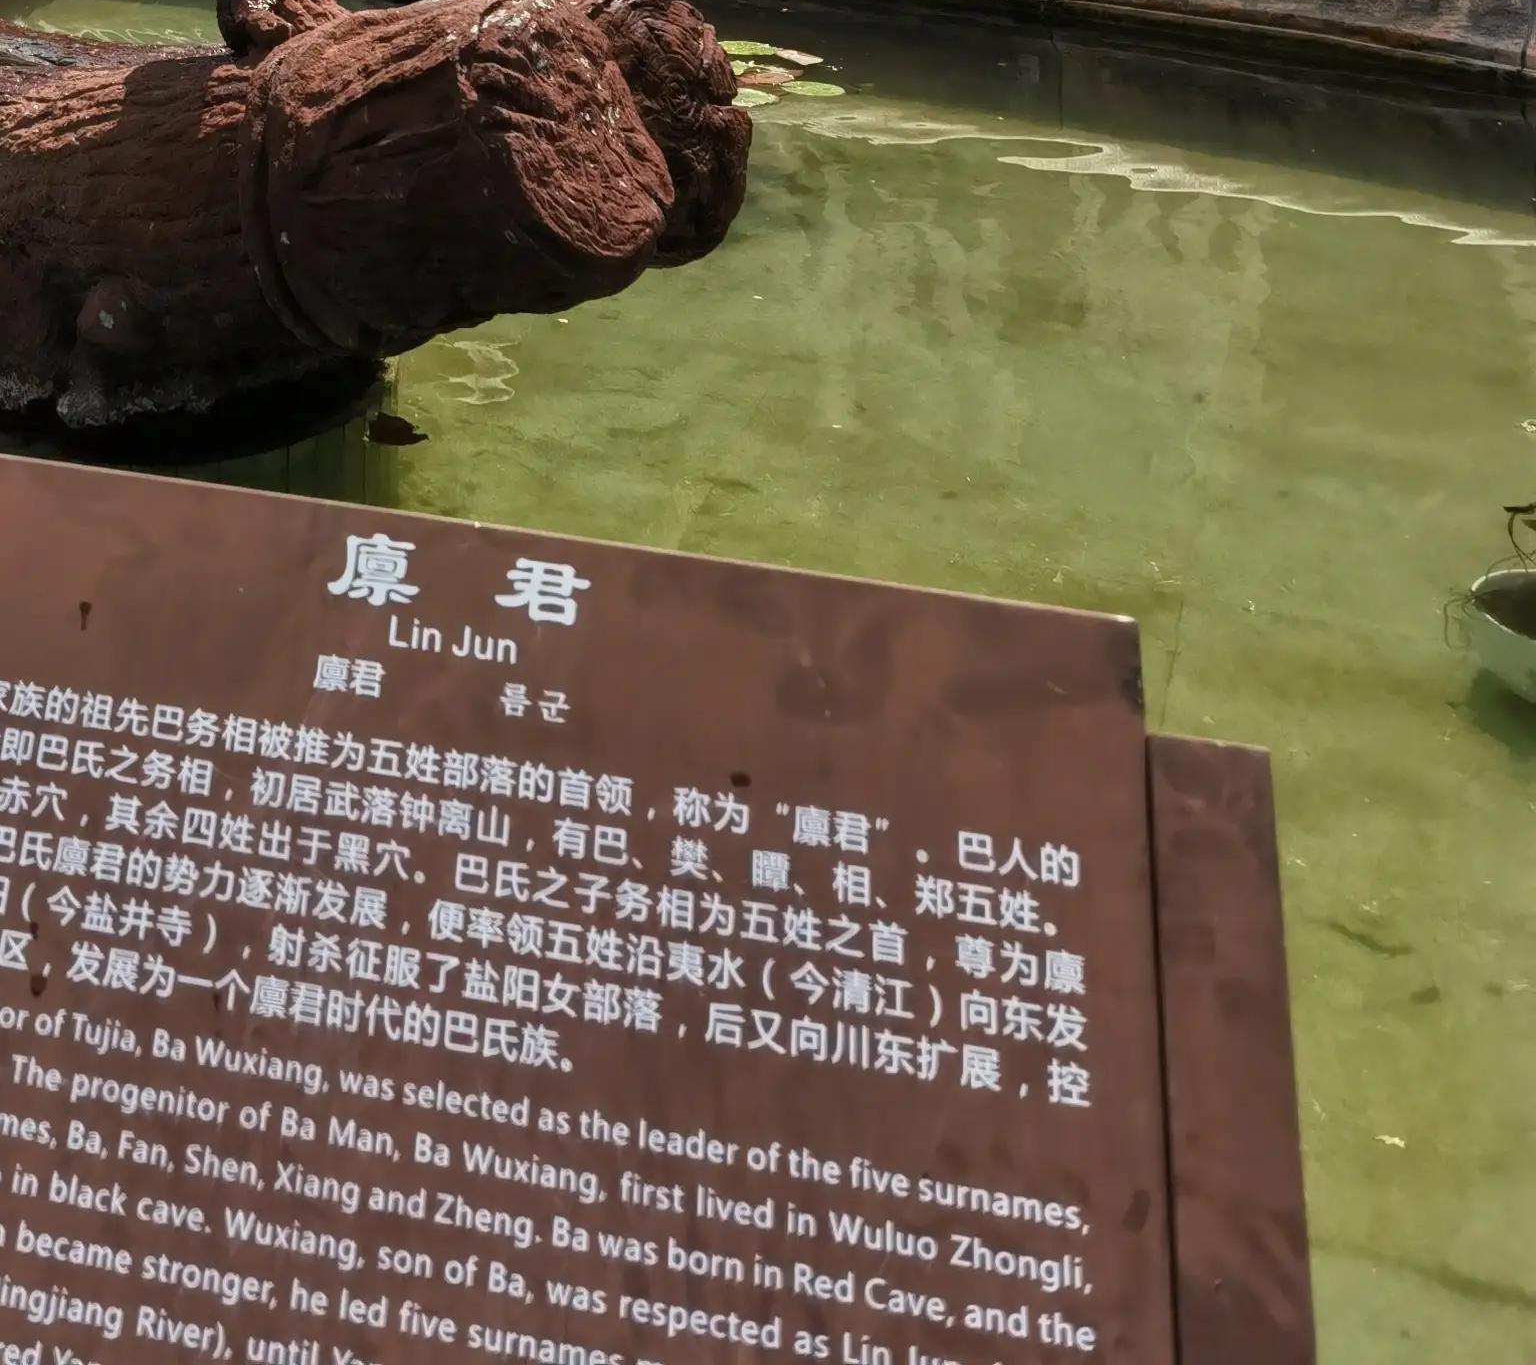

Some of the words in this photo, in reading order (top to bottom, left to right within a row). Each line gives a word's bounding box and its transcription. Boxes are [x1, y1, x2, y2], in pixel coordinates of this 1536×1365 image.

[388, 614, 442, 653] Lin
[451, 625, 518, 665] Jun
[12, 1053, 63, 1092] The
[69, 1073, 230, 1124] progenitor
[238, 1101, 273, 1132] of
[280, 1106, 316, 1141] Ba
[328, 1115, 400, 1162] Man,
[414, 1131, 451, 1168] Ba
[462, 1141, 607, 1205] Wuxiang,
[620, 1170, 685, 1214] first
[696, 1184, 774, 1230] lived
[786, 1202, 817, 1237] in
[828, 1210, 938, 1261] Wuluo
[949, 1233, 1093, 1295] Zhongli,
[34, 1008, 67, 1038] of
[71, 1012, 142, 1057] Tujia,
[152, 1027, 187, 1062] Ba
[195, 1035, 330, 1095] Wuxiang,
[339, 1069, 395, 1102] was
[402, 1079, 530, 1128] selected
[537, 1107, 571, 1135] as
[579, 1109, 631, 1147] the
[638, 1118, 740, 1165] leader
[746, 1141, 782, 1173] of
[787, 1147, 842, 1185] the
[849, 1156, 911, 1198] five
[918, 1178, 1090, 1236] surnames,
[11, 1162, 39, 1198] in
[48, 1170, 127, 1216] black
[136, 1197, 211, 1234] cave.
[224, 1206, 365, 1272] Wuxiang,
[377, 1246, 434, 1278] son
[444, 1254, 479, 1287] of
[487, 1260, 534, 1304] Ba,
[546, 1280, 607, 1314] was
[619, 1295, 782, 1350] respected
[793, 1330, 830, 1359] as
[842, 1331, 892, 1365] Lin
[15, 1219, 133, 1275] became
[141, 1253, 278, 1310] stronger,
[290, 1276, 329, 1316] he
[339, 1287, 389, 1328] led
[398, 1300, 458, 1343] five
[66, 1119, 108, 1160] Ba,
[117, 1129, 174, 1173] Fan,
[184, 1143, 265, 1191] Shen,
[273, 1160, 361, 1215] Xiang
[367, 1186, 428, 1219] and
[433, 1192, 542, 1249] Zheng.
[551, 1215, 590, 1253] Ba
[598, 1231, 659, 1266] was
[667, 1236, 745, 1283] born
[753, 1253, 784, 1290] in
[793, 1262, 855, 1304] Red
[864, 1277, 955, 1328] Cave,
[963, 1304, 1029, 1339] and
[1037, 1311, 1096, 1352] the
[136, 1305, 232, 1360] River),
[246, 1336, 320, 1365] until
